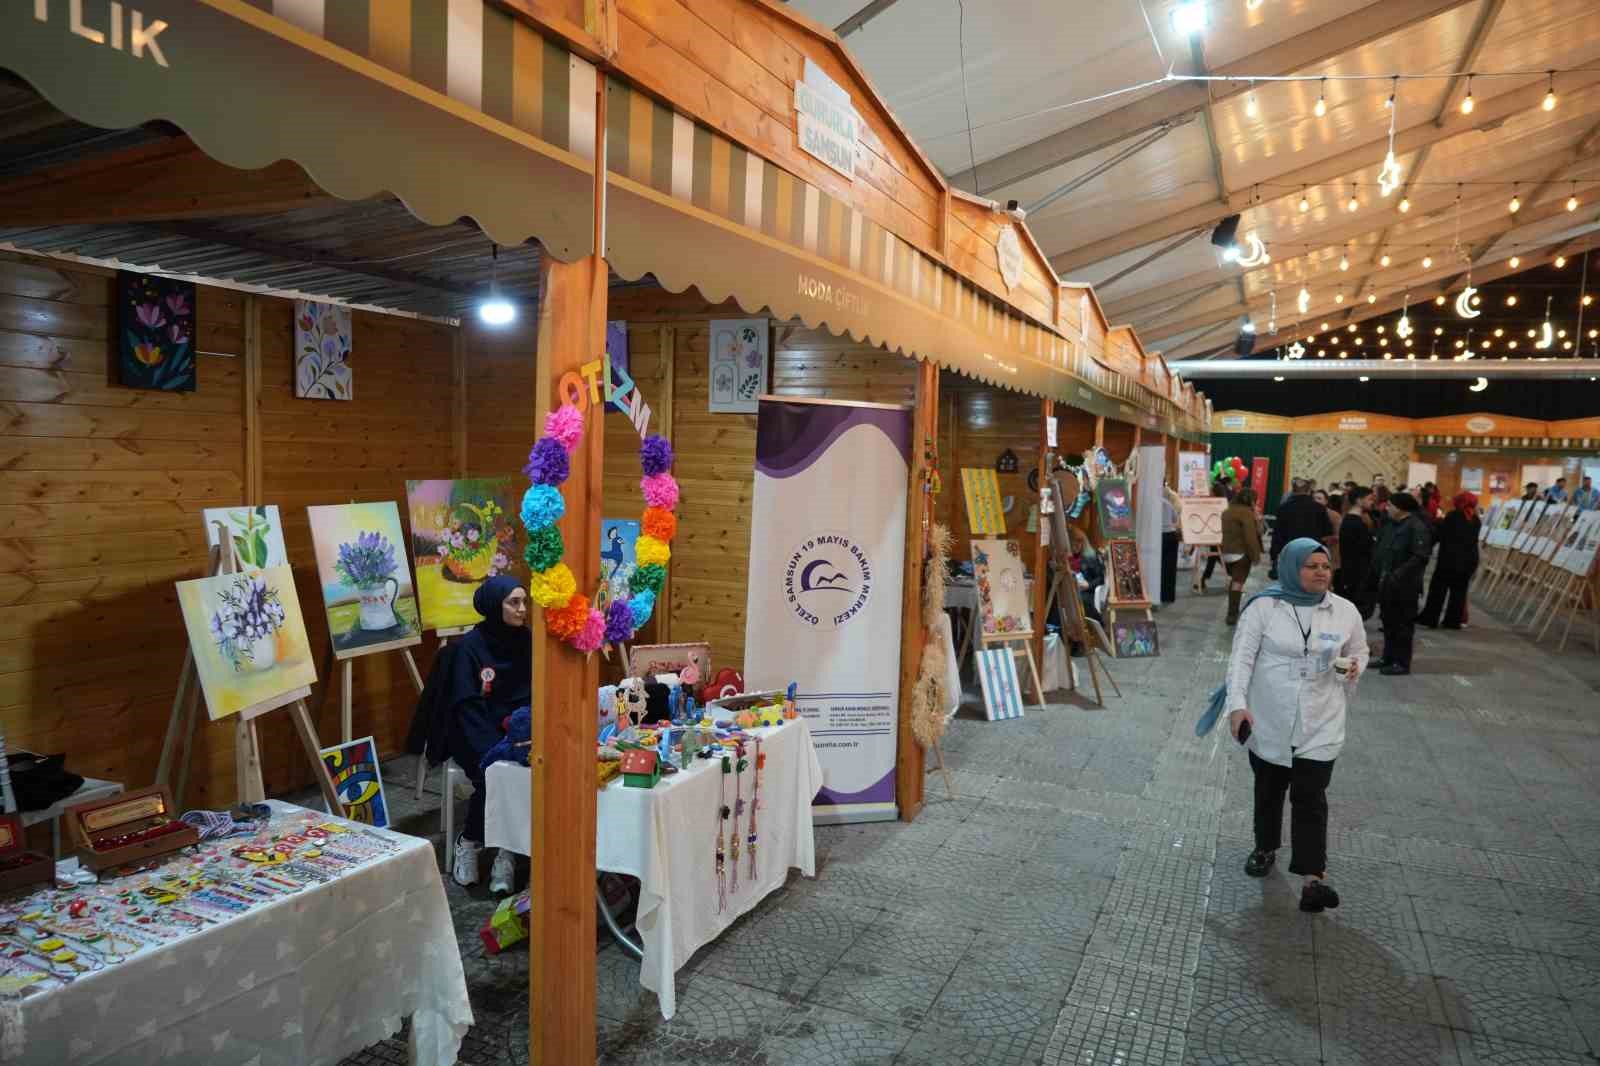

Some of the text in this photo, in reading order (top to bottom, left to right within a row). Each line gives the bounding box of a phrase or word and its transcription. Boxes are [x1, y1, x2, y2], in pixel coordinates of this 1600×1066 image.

[798, 272, 832, 304] MODA
[785, 552, 802, 603] SAMSUN
[801, 540, 815, 552] 19
[816, 535, 849, 548] MAYIS
[850, 545, 871, 581] BAKIM
